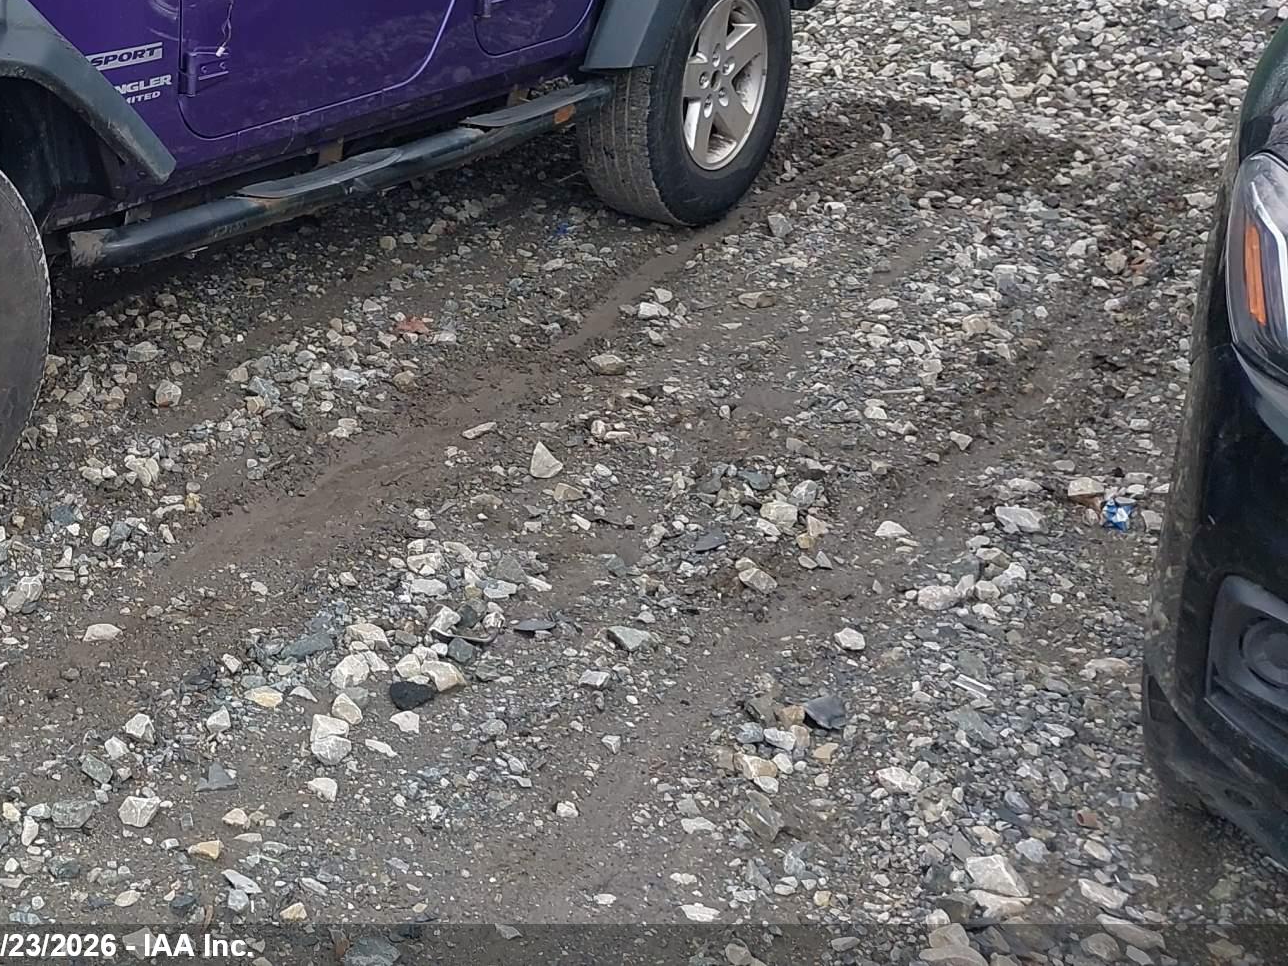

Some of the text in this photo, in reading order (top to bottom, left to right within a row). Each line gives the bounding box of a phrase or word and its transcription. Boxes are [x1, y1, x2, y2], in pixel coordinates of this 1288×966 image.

[90, 45, 161, 67] SPORT
[114, 74, 172, 95] NGLER
[126, 90, 161, 105] ITED
